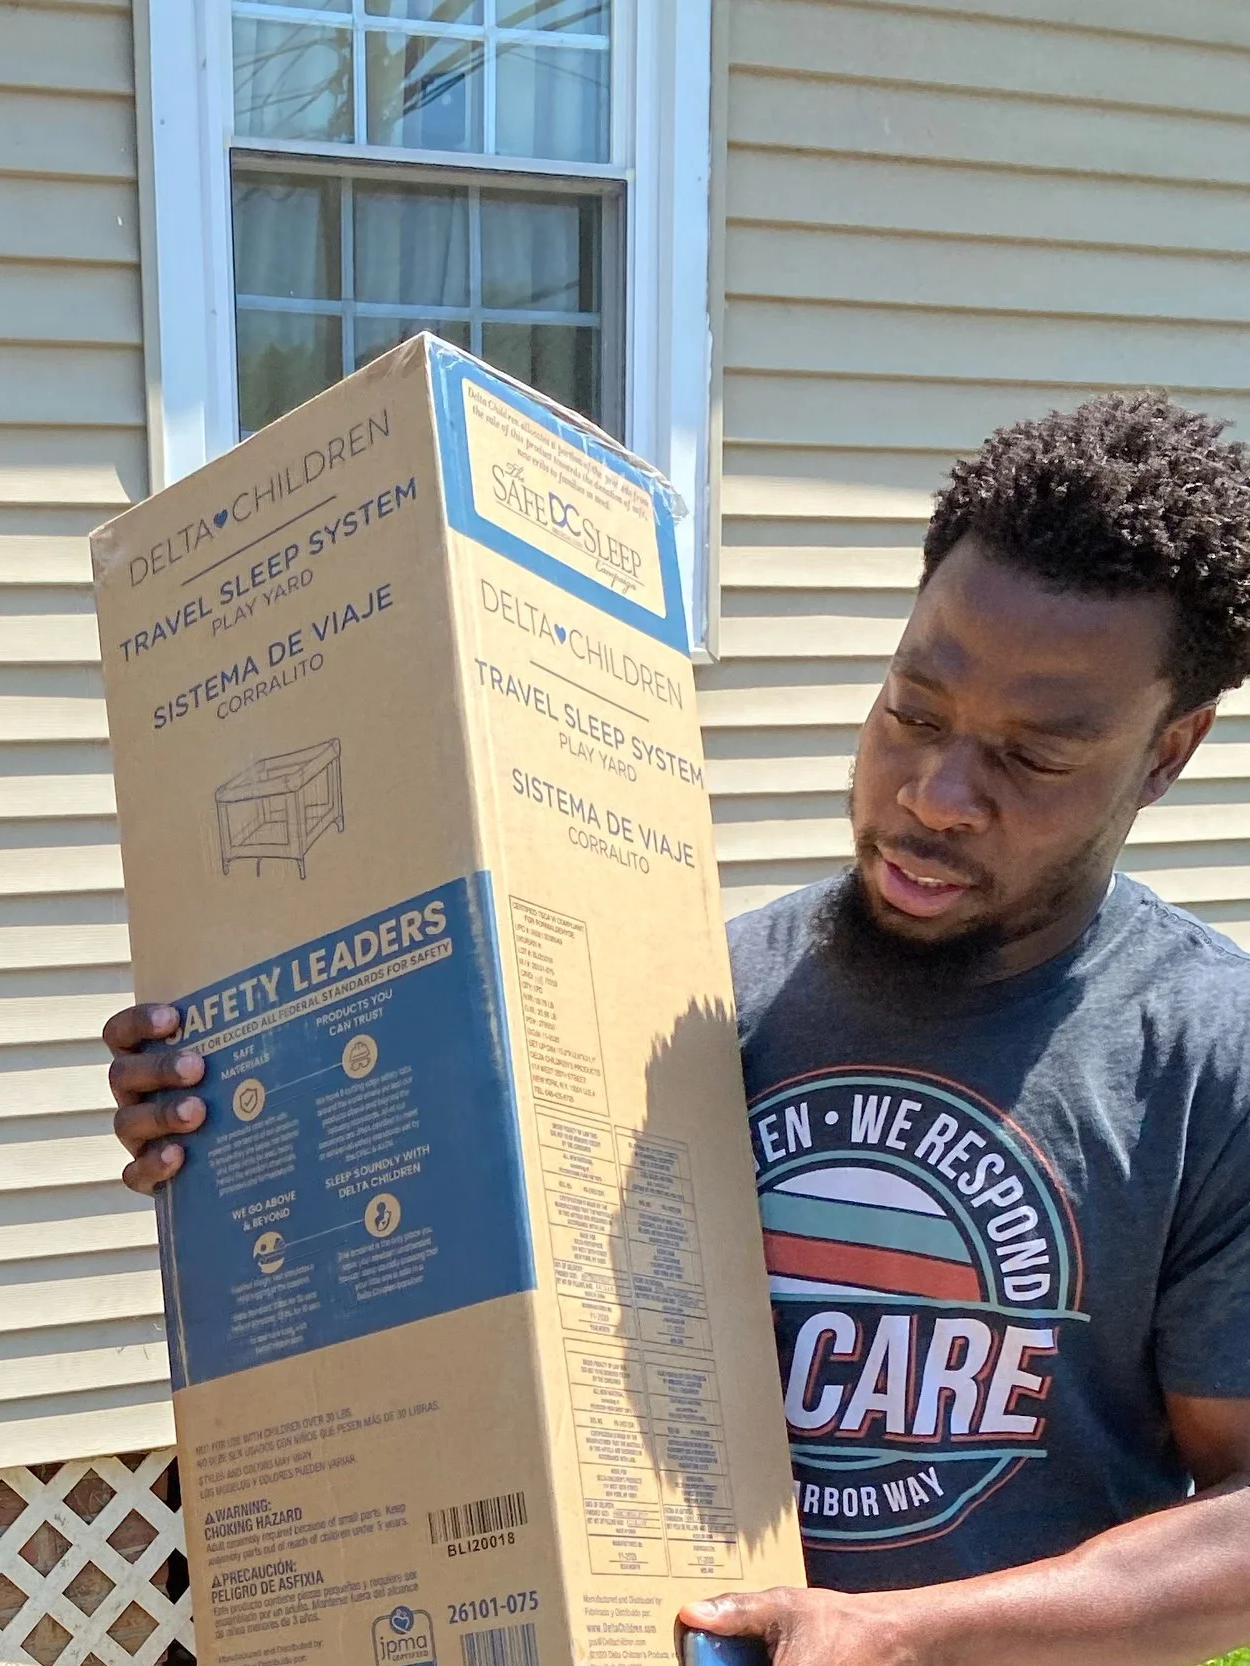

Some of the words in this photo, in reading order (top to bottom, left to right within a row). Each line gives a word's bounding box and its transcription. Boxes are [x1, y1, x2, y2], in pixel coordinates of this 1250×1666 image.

[505, 462, 525, 483] The
[130, 518, 214, 588] DELTA
[232, 409, 390, 523] CHILDREN
[492, 464, 548, 526] SAFE
[582, 518, 642, 578] SLEEP
[119, 597, 213, 662] TRAVEL
[220, 543, 300, 606] SLEEP
[309, 477, 417, 556] SYSTEM
[596, 558, 637, 594] Campaign
[212, 598, 258, 636] PLAY
[263, 568, 313, 606] YARD
[154, 655, 260, 729] SISTEMA
[268, 629, 304, 668] DE
[311, 583, 394, 642] VIAJE
[481, 578, 555, 646] DELTA
[569, 629, 683, 710] CHILDREN
[216, 653, 324, 720] CORRALITO
[474, 658, 559, 722] TRAVEL
[564, 703, 624, 750] SLEEP
[632, 736, 704, 790] SYSTEM
[559, 732, 594, 764] PLAY
[599, 750, 637, 782] YARD
[512, 768, 601, 828] SISTEMA
[606, 810, 634, 843] DE
[638, 824, 695, 869] VIAJE
[568, 826, 650, 874] CORRALITO
[291, 900, 446, 992] LEADERS
[208, 1032, 220, 1048] OR
[223, 1017, 258, 1042] EXCEED
[261, 1010, 277, 1027] ALL
[278, 993, 319, 1020] FEDERAL
[322, 967, 384, 1004] STANDARDS
[387, 958, 407, 978] FOR
[410, 941, 450, 969] SAFETY
[316, 996, 369, 1027] PRODUCTS
[371, 989, 393, 1008] YOU
[329, 1020, 351, 1037] CAN
[353, 1008, 383, 1029] TRUST
[221, 1053, 270, 1080] MATERIALS
[233, 1045, 255, 1061] SAFE
[325, 1171, 352, 1190] SLEEP
[353, 1154, 400, 1180] SOUNDLY
[402, 1144, 430, 1162] WITH
[339, 1181, 369, 1198] DELTA
[371, 1163, 421, 1187] CHILDREN
[232, 1207, 246, 1220] WE
[248, 1202, 262, 1214] GO
[265, 1190, 296, 1210] ABOVE
[753, 1102, 812, 1172] EN
[851, 1094, 923, 1151] WE
[915, 1113, 1050, 1302] RESPOND
[253, 1208, 290, 1228] BEYOND
[785, 1311, 1057, 1441] CARE
[243, 1429, 263, 1443] WITH
[264, 1420, 301, 1438] CHILDREN
[303, 1414, 323, 1429] OVER
[326, 1411, 335, 1423] 30
[277, 1436, 292, 1449] CON
[320, 1425, 335, 1439] QUE
[337, 1419, 362, 1435] PESEN
[364, 1412, 382, 1428] MÁS
[384, 1411, 394, 1423] DE
[397, 1408, 406, 1420] 30
[200, 1486, 214, 1500] LOS
[259, 1469, 294, 1486] COLORES
[295, 1462, 325, 1478] PUEDEN
[227, 1467, 242, 1480] AND
[793, 1480, 879, 1517] RBOR
[883, 1467, 945, 1513] WAY
[204, 1518, 253, 1540] CHOKING
[257, 1507, 303, 1530] HAZARD
[215, 1499, 272, 1522] WARNING:
[294, 1519, 326, 1535] because
[328, 1517, 336, 1528] of
[447, 1532, 516, 1558] BLI20018
[212, 1583, 257, 1604] PELIGRO
[261, 1580, 275, 1595] DE
[279, 1571, 324, 1591] ASFIXIA
[222, 1559, 297, 1585] PRECAUCIÓN:
[214, 1605, 228, 1616] Este
[447, 1590, 540, 1625] 26101-075
[380, 1635, 427, 1660] jpma
